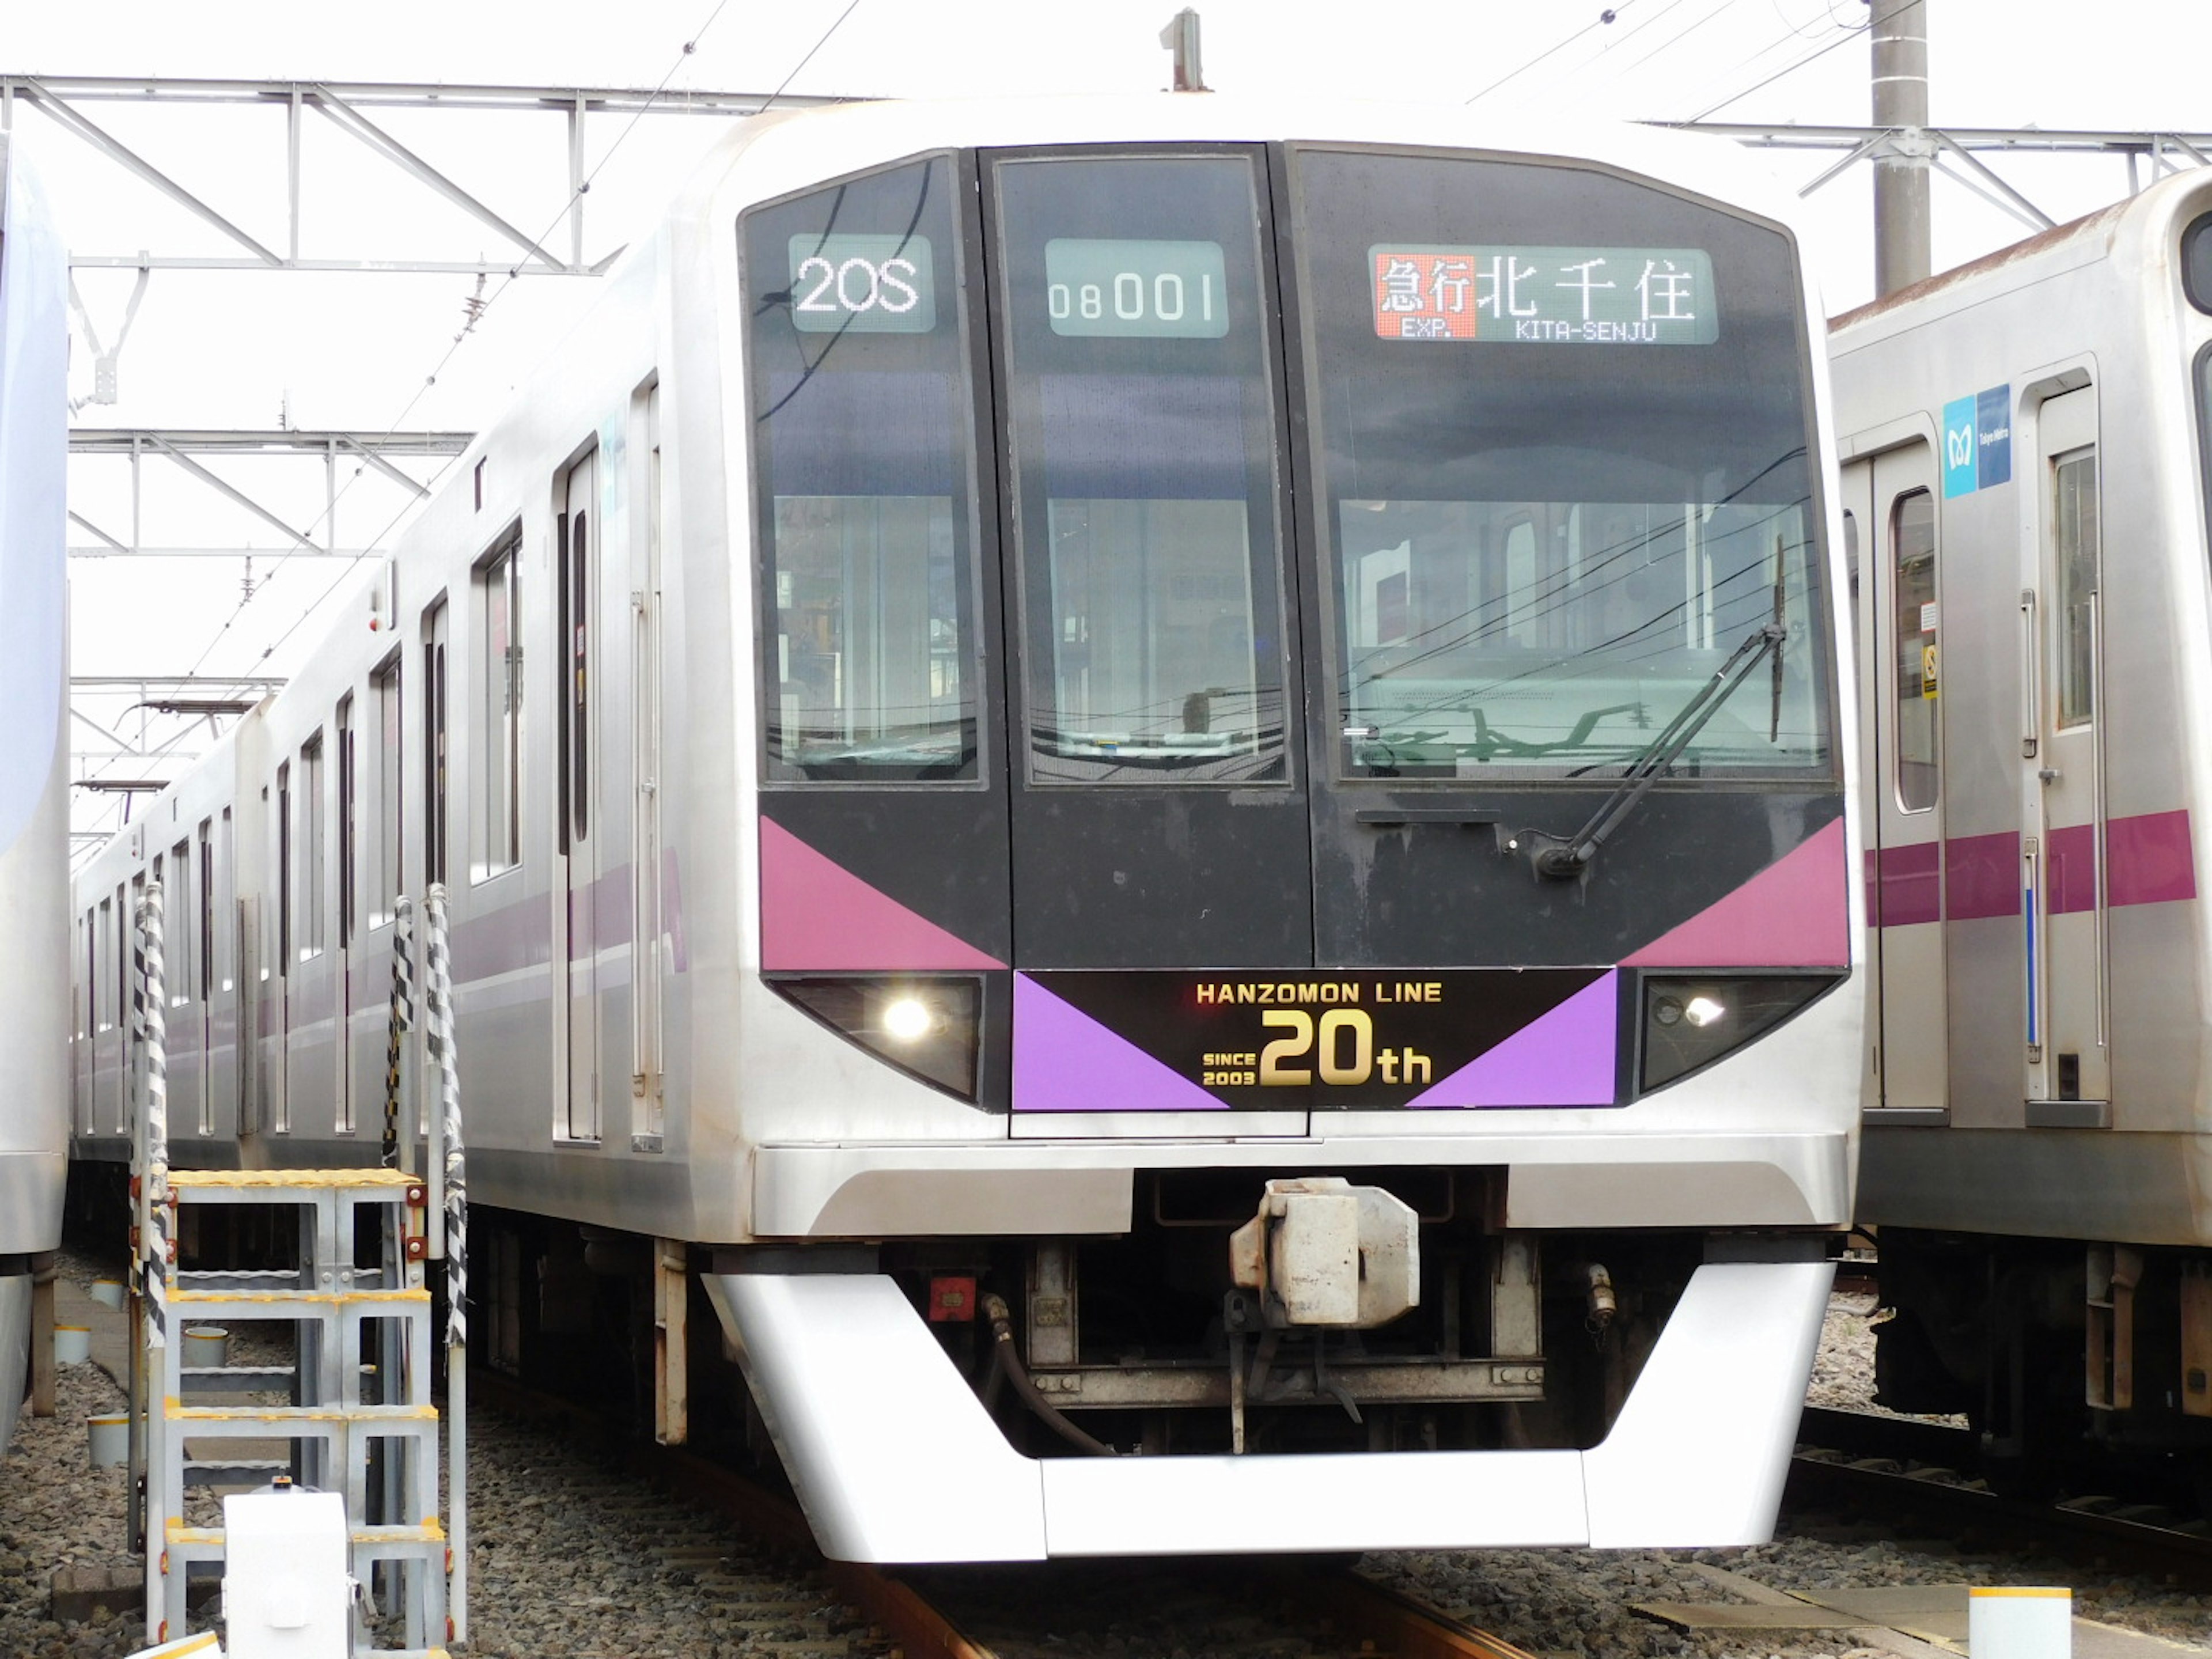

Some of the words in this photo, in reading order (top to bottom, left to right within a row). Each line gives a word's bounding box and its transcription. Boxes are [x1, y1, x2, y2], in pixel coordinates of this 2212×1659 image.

[797, 257, 919, 313] 20S
[1382, 258, 1470, 313] 急行
[1476, 256, 1696, 320] 北千住
[1401, 318, 1452, 338] EXP.
[1516, 320, 1657, 341] KITA-SENJU
[1196, 983, 1359, 1004] HANZOMON
[1375, 982, 1442, 1003] LINE
[1259, 1008, 1432, 1086] 20th
[1202, 1053, 1256, 1066] SINCE
[1202, 1071, 1256, 1086] 2003
